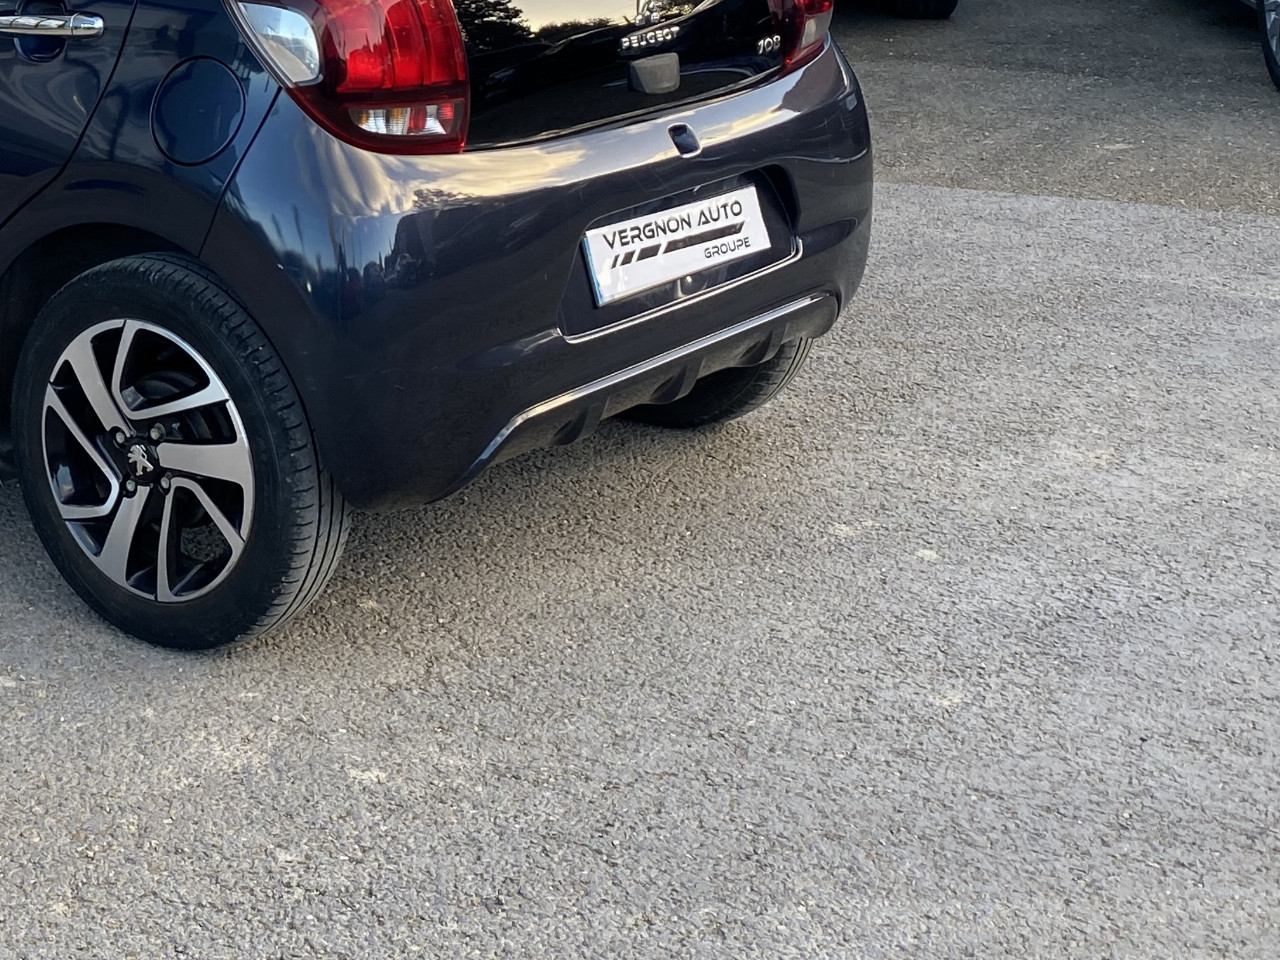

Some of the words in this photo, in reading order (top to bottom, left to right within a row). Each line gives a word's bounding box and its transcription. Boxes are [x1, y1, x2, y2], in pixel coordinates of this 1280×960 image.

[621, 26, 680, 51] PEUGEOT
[757, 35, 781, 55] 108
[602, 213, 692, 249] VERGNON
[697, 200, 743, 227] AUTO
[704, 236, 751, 259] GROUPE
